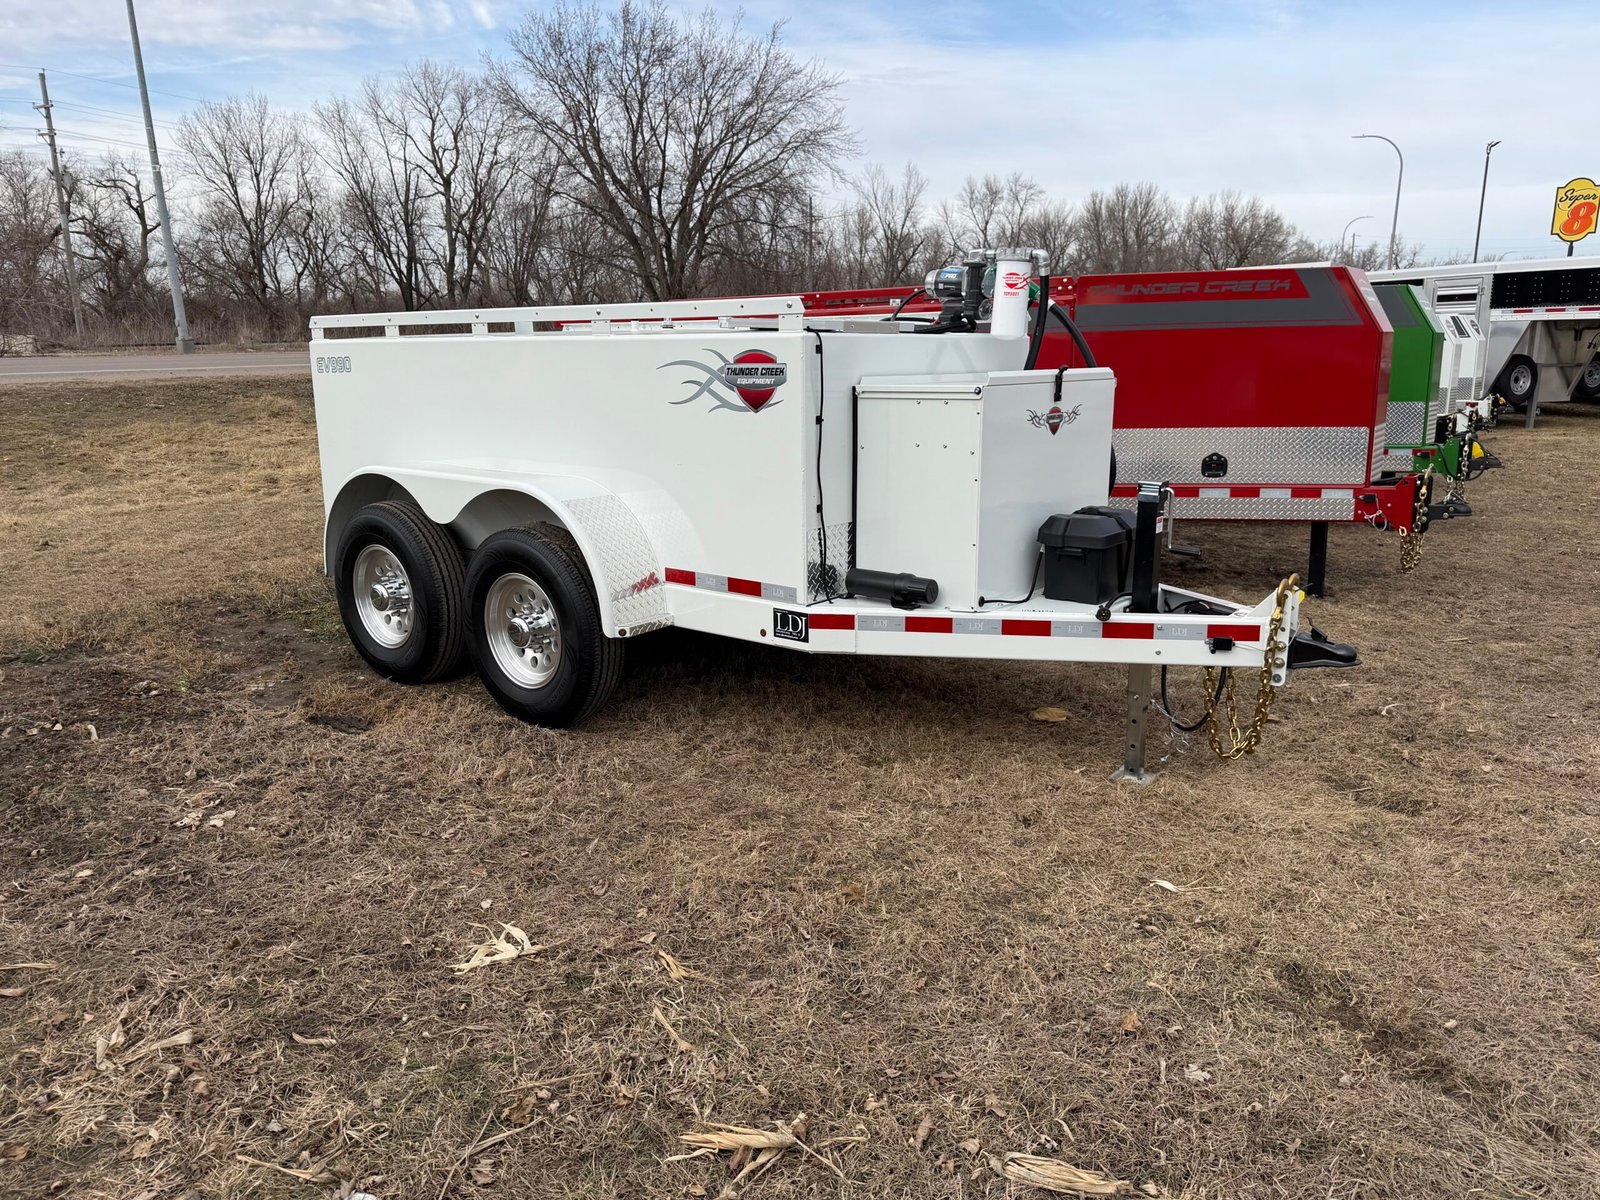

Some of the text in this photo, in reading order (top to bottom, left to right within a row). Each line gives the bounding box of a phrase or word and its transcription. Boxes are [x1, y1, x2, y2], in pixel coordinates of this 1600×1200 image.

[1559, 188, 1598, 208] Super
[1559, 201, 1597, 236] 8
[1089, 279, 1291, 296] THUNDER CREEK
[316, 356, 352, 373] EV990
[726, 367, 785, 376] THUNDER CREEK
[775, 612, 807, 640] LDJ
